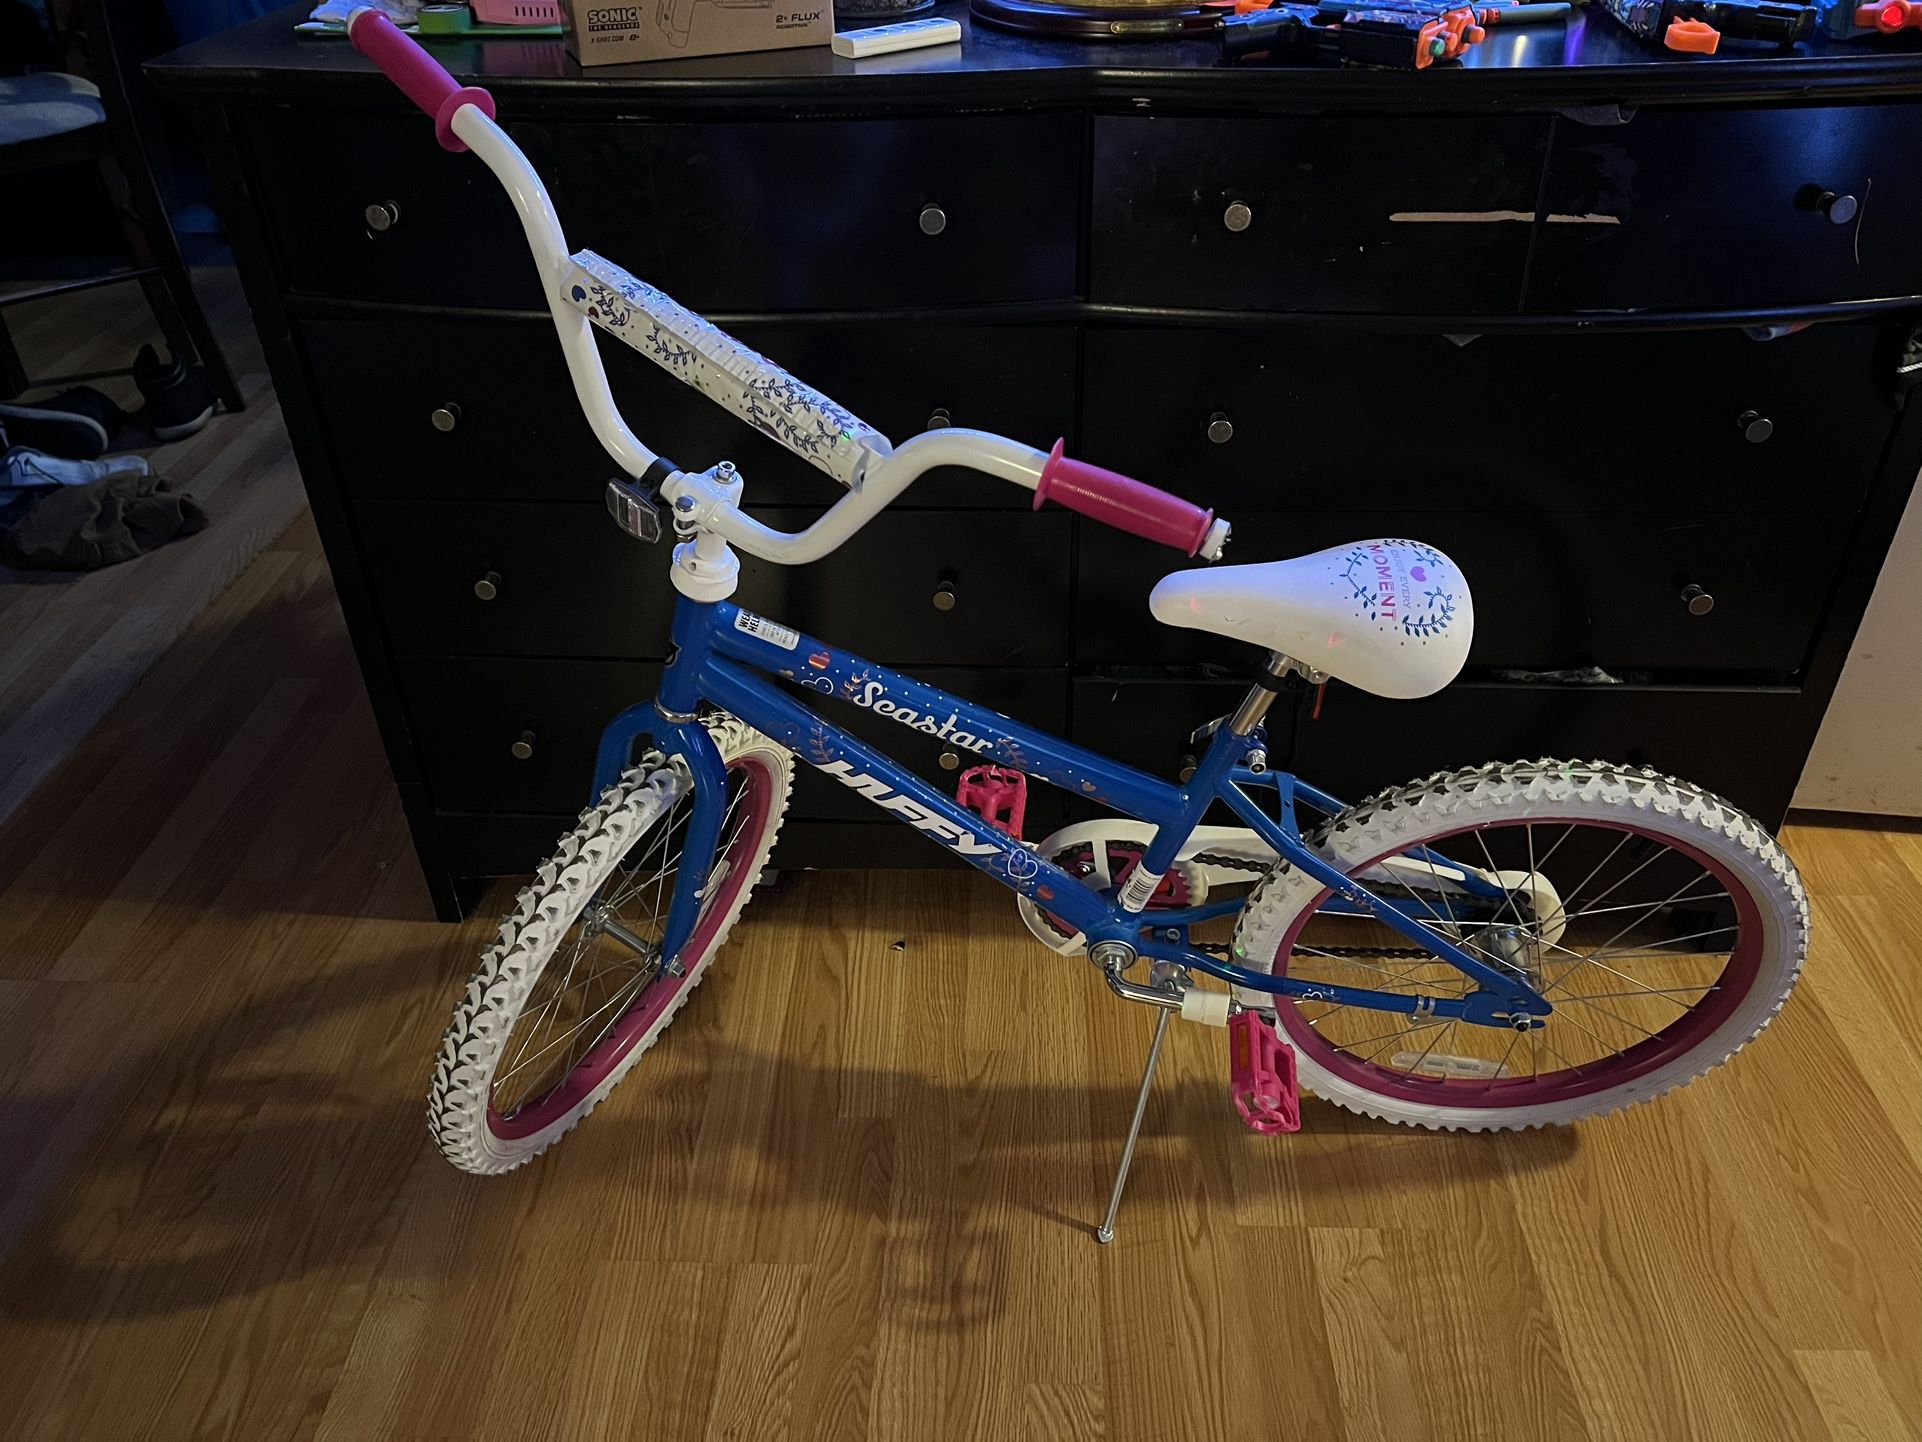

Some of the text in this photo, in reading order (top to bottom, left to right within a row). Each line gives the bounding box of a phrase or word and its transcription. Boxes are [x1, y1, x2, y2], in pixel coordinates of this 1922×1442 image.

[587, 7, 638, 24] SONIC
[791, 11, 820, 21] FLUX
[1367, 544, 1396, 621] MOMENT
[1400, 576, 1411, 609] EVERY
[853, 681, 993, 753] Seastar
[815, 760, 1002, 855] HUFFY
